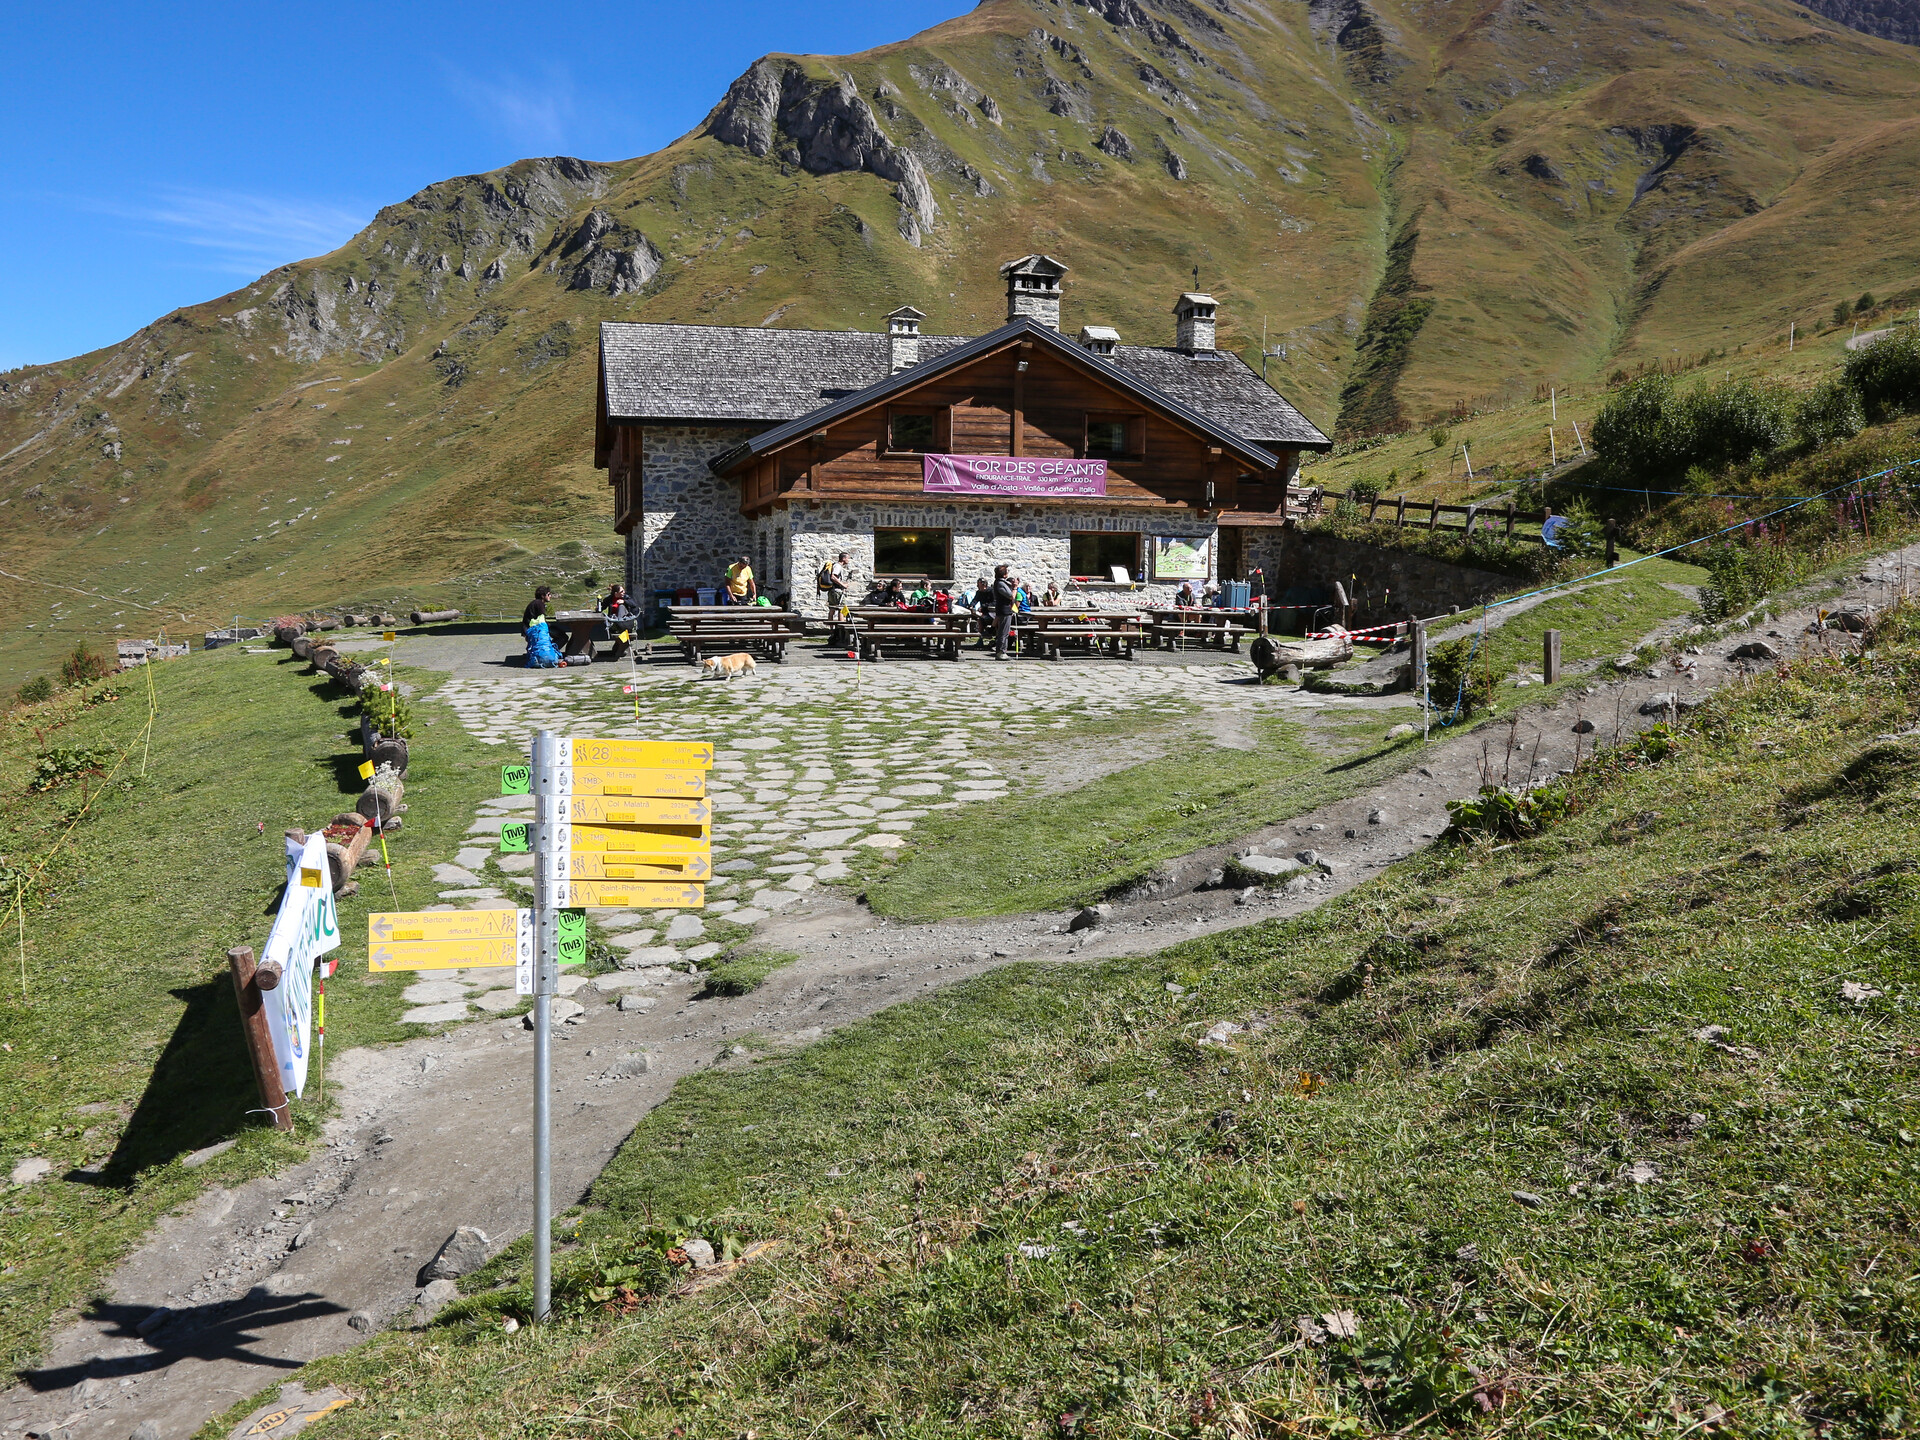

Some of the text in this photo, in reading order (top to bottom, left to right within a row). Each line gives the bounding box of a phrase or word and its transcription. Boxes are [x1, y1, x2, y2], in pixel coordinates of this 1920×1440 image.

[967, 460, 1104, 476] TOR DES GÉANTS
[976, 474, 1031, 482] ENDURANCE-TRAIL
[971, 482, 989, 490] Valle
[991, 483, 1018, 491] d'Aosta
[1023, 484, 1046, 492] Vallée
[592, 747, 610, 760] 28
[506, 769, 527, 781] TMB
[607, 800, 619, 808] Col
[593, 808, 598, 816] 1
[505, 826, 525, 839] TMB
[593, 864, 598, 873] 1
[600, 885, 647, 893] Saint-Rhémy
[586, 892, 591, 901] 1
[393, 917, 418, 925] Rifugio
[423, 916, 453, 924] Bertone
[561, 911, 581, 923] TMB
[488, 922, 492, 931] 1
[561, 939, 581, 952] TMB
[393, 946, 439, 955] Courmayeur
[448, 956, 472, 964] difficoltà
[488, 951, 492, 960] 1
